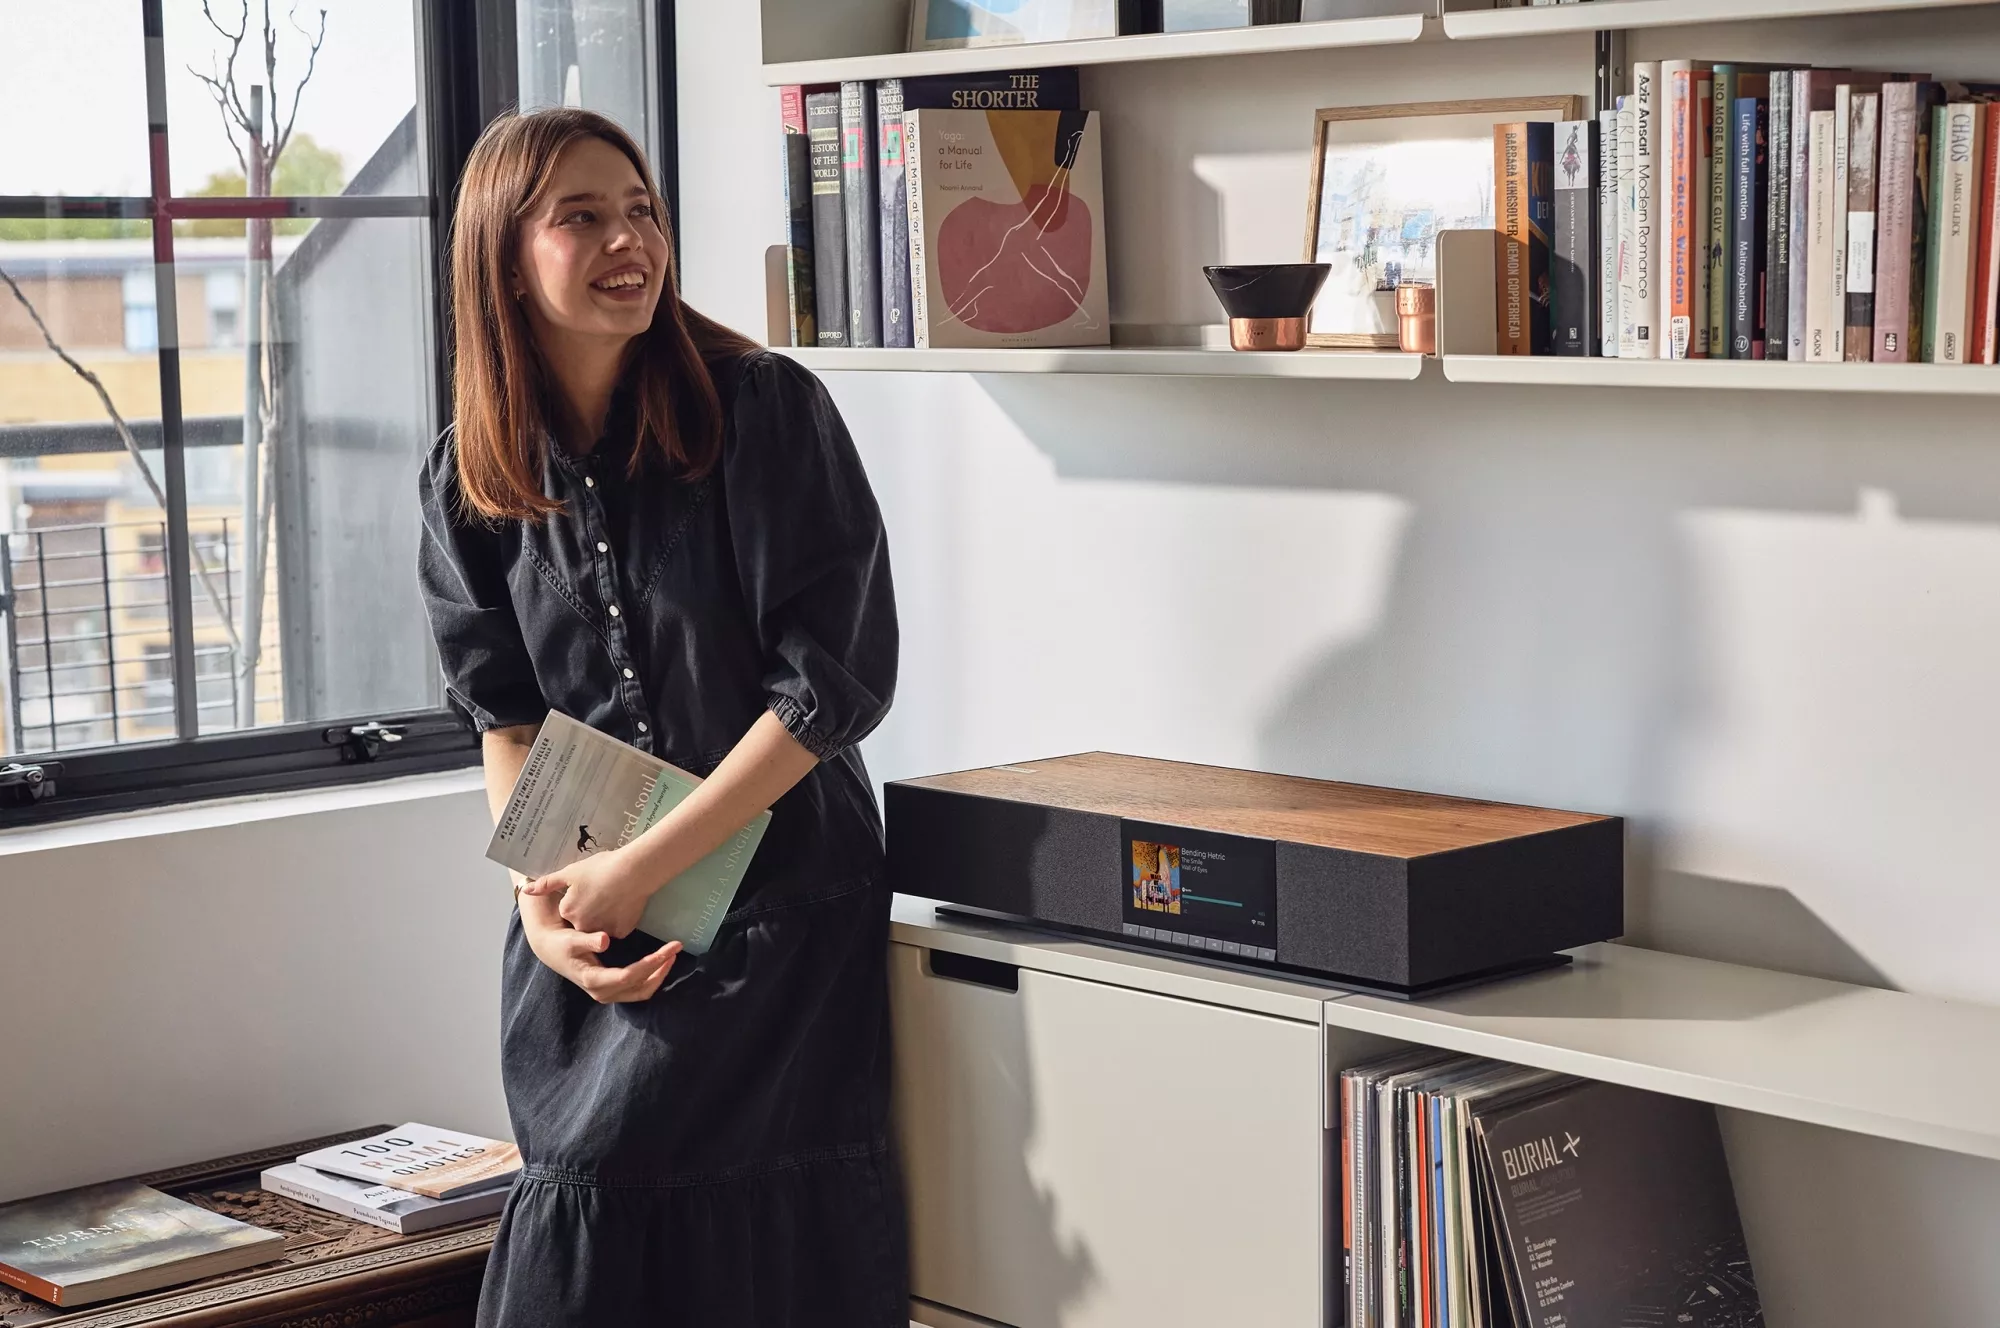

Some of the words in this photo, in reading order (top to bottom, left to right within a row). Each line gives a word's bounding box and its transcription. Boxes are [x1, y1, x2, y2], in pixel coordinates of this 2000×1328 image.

[1010, 75, 1039, 89] THE
[1638, 73, 1651, 104] Aziz
[1715, 82, 1724, 101] NO
[809, 105, 839, 116] ROBERTS
[879, 94, 904, 105] OXFORD
[879, 104, 904, 114] ENGLISH
[952, 90, 1038, 108] SHORTER
[939, 131, 965, 142] Yoga:
[1638, 108, 1651, 157] Ansari
[1715, 105, 1724, 142] MORE
[1741, 113, 1750, 133] Life
[1950, 113, 1971, 162] CHAOS
[811, 143, 840, 153] HISTORY
[947, 145, 982, 155] Manual
[1505, 132, 1517, 177] BARBARA
[1609, 118, 1618, 196] EVERYDAY
[1714, 146, 1724, 169] MR.
[1741, 135, 1750, 155] with
[1836, 136, 1845, 181] ETHICS
[813, 156, 822, 166] OF
[823, 155, 839, 165] THE
[813, 168, 839, 178] WORLD
[939, 160, 953, 169] for
[955, 160, 972, 169] Life
[1740, 157, 1750, 173] full
[1638, 164, 1650, 225] Modern
[1713, 172, 1723, 203] NICE
[1740, 174, 1749, 220] attention
[1778, 185, 1787, 215] History
[1954, 172, 1963, 201] JAMES
[1506, 179, 1518, 236] KINGSOLVER
[1712, 206, 1723, 233] GUY
[1770, 196, 1779, 231] Freedom
[1779, 217, 1787, 226] of
[1952, 204, 1962, 237] GLEICK
[1507, 242, 1519, 276] DEMON
[1637, 226, 1650, 299] Romance
[1777, 233, 1787, 264] Symbol
[1605, 246, 1613, 295] KINGSLEY
[1674, 235, 1686, 305] Wisdom
[1737, 241, 1749, 321] Maitreyabandhu
[1507, 278, 1520, 339] COPPERHEAD
[1605, 297, 1614, 323] AMIS
[818, 331, 842, 339] OXFORD
[1813, 329, 1821, 357] PICADOR
[504, 816, 513, 830] NEW
[510, 798, 521, 815] YORK
[518, 777, 531, 797] TIMES
[528, 737, 549, 776] BESTSELLER
[508, 822, 517, 836] MORE
[514, 810, 523, 822] THAN
[525, 779, 537, 799] MILLION
[534, 760, 545, 779] COPIES
[635, 773, 658, 814] soul
[645, 802, 660, 823] beyond
[654, 781, 671, 804] yourself
[1181, 847, 1207, 860] Bending
[1181, 856, 1190, 864] The
[690, 888, 724, 945] MICHAEL
[726, 822, 755, 871] SINGER
[341, 1138, 414, 1158] 100
[360, 1140, 461, 1170] RUMI
[392, 1146, 485, 1176] QUOTES
[1502, 1136, 1563, 1180] BURIAL
[40, 1240, 67, 1249] AND
